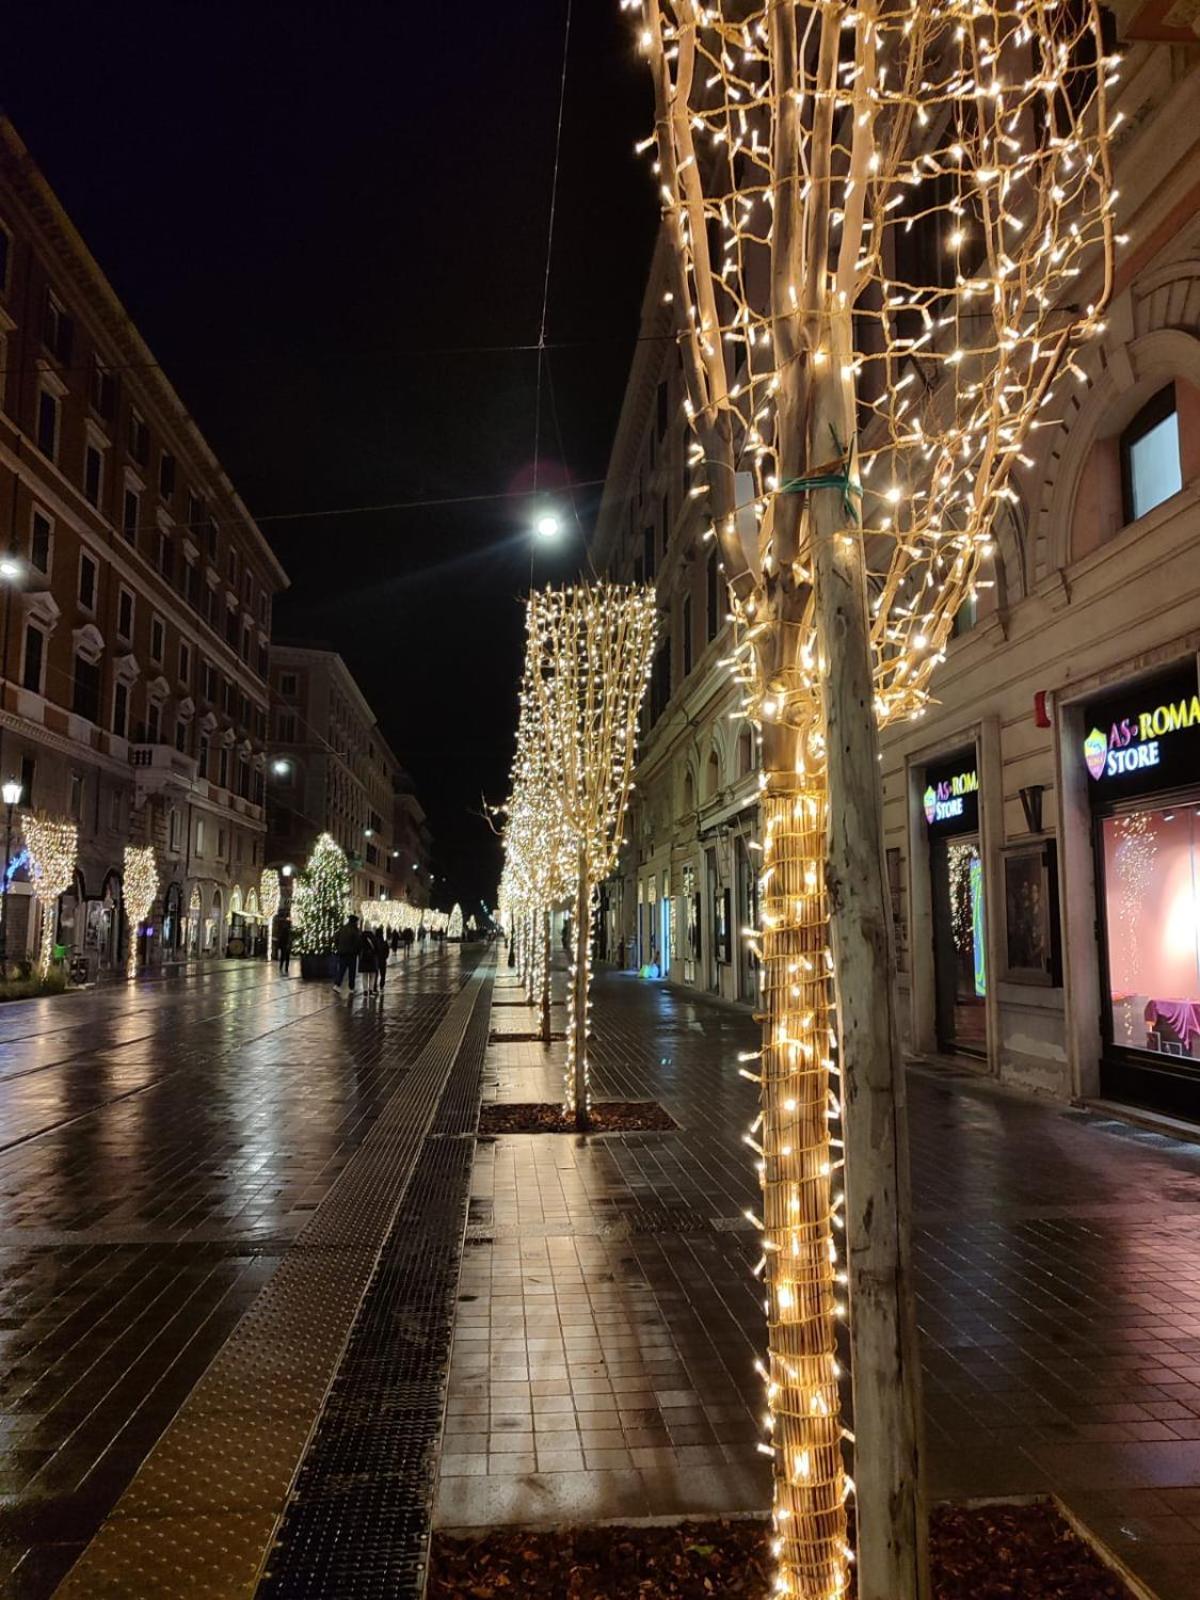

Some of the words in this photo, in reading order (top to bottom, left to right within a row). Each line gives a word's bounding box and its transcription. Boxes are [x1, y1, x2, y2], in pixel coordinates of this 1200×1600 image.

[1109, 718, 1131, 749] AS
[1138, 695, 1200, 742] ROMA
[1107, 741, 1160, 776] STORE
[937, 781, 950, 801] AS
[936, 797, 963, 820] STORE
